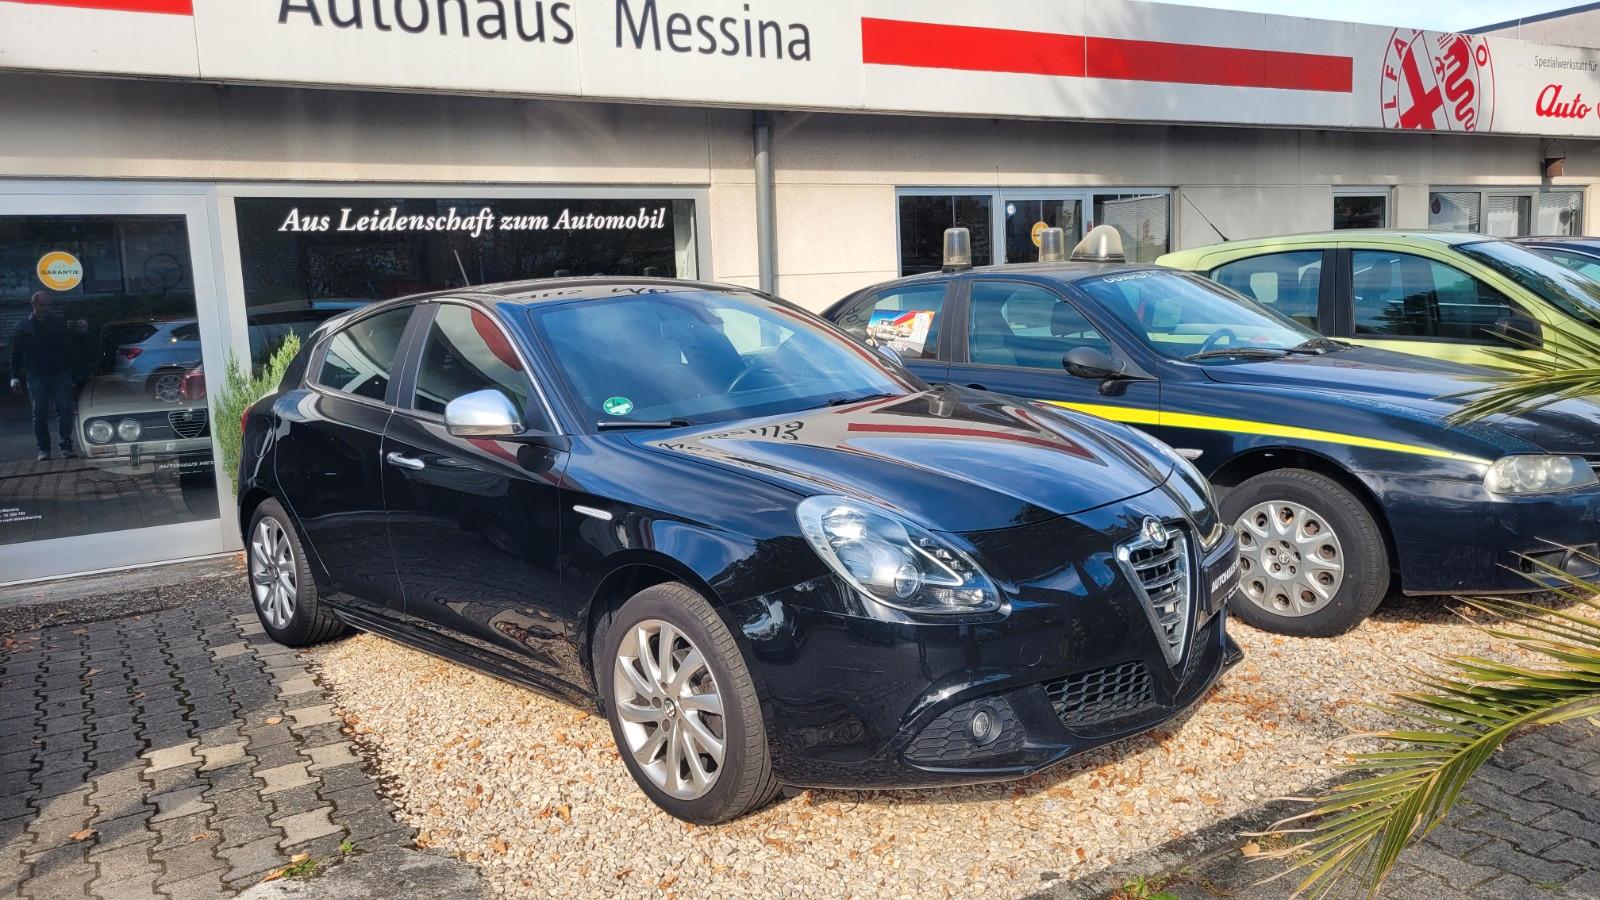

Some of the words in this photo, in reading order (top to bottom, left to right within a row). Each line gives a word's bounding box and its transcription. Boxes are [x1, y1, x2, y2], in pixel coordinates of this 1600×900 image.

[615, 0, 811, 62] Messina
[1534, 55, 1588, 71] Spezialwerkstatt
[1588, 59, 1598, 72] für
[1383, 37, 1408, 129] LFA
[278, 207, 330, 232] Aus
[336, 207, 495, 238] Leidenschaft
[499, 214, 550, 231] zum
[553, 207, 667, 230] Automobil
[159, 462, 198, 470] AUTOHAUS
[1211, 561, 1236, 594] AUTOHAUS
